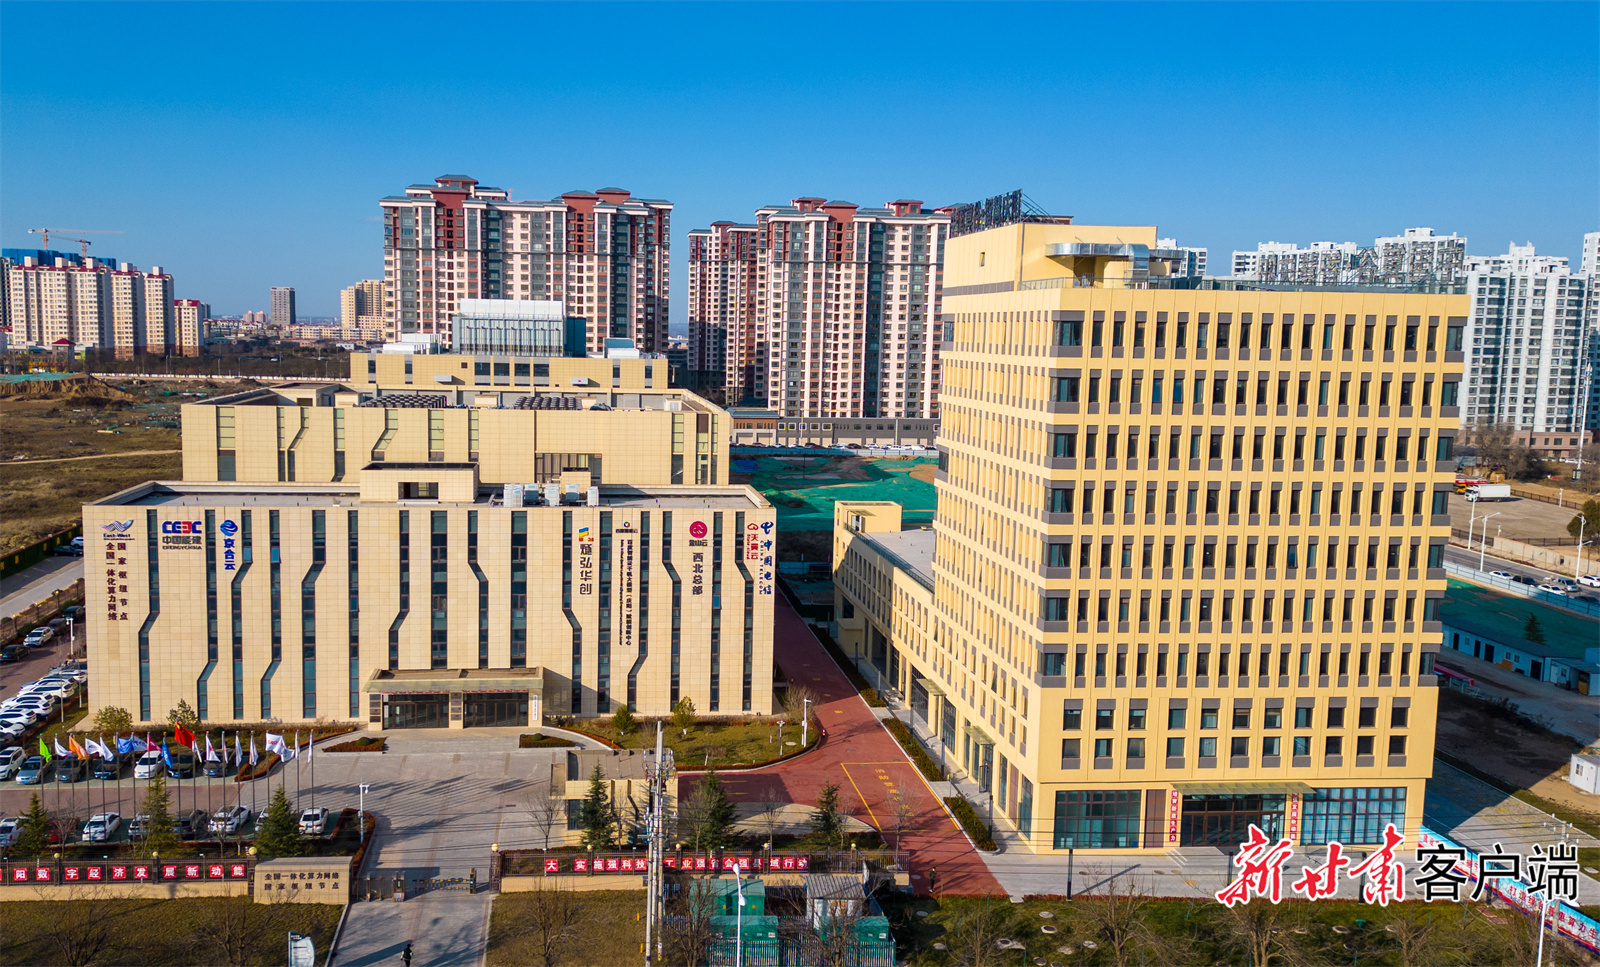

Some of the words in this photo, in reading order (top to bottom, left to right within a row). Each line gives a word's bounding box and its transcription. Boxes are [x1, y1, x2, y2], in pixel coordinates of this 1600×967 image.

[162, 536, 202, 545] 中国能建
[105, 542, 118, 621] 全国一体化算力网络
[117, 543, 129, 621] 国家枢纽节点
[692, 552, 704, 596] 西北总部
[763, 539, 773, 595] 中国电信
[264, 872, 340, 881] 全国一体化算力网络
[264, 882, 340, 890] 国家枢纽节点
